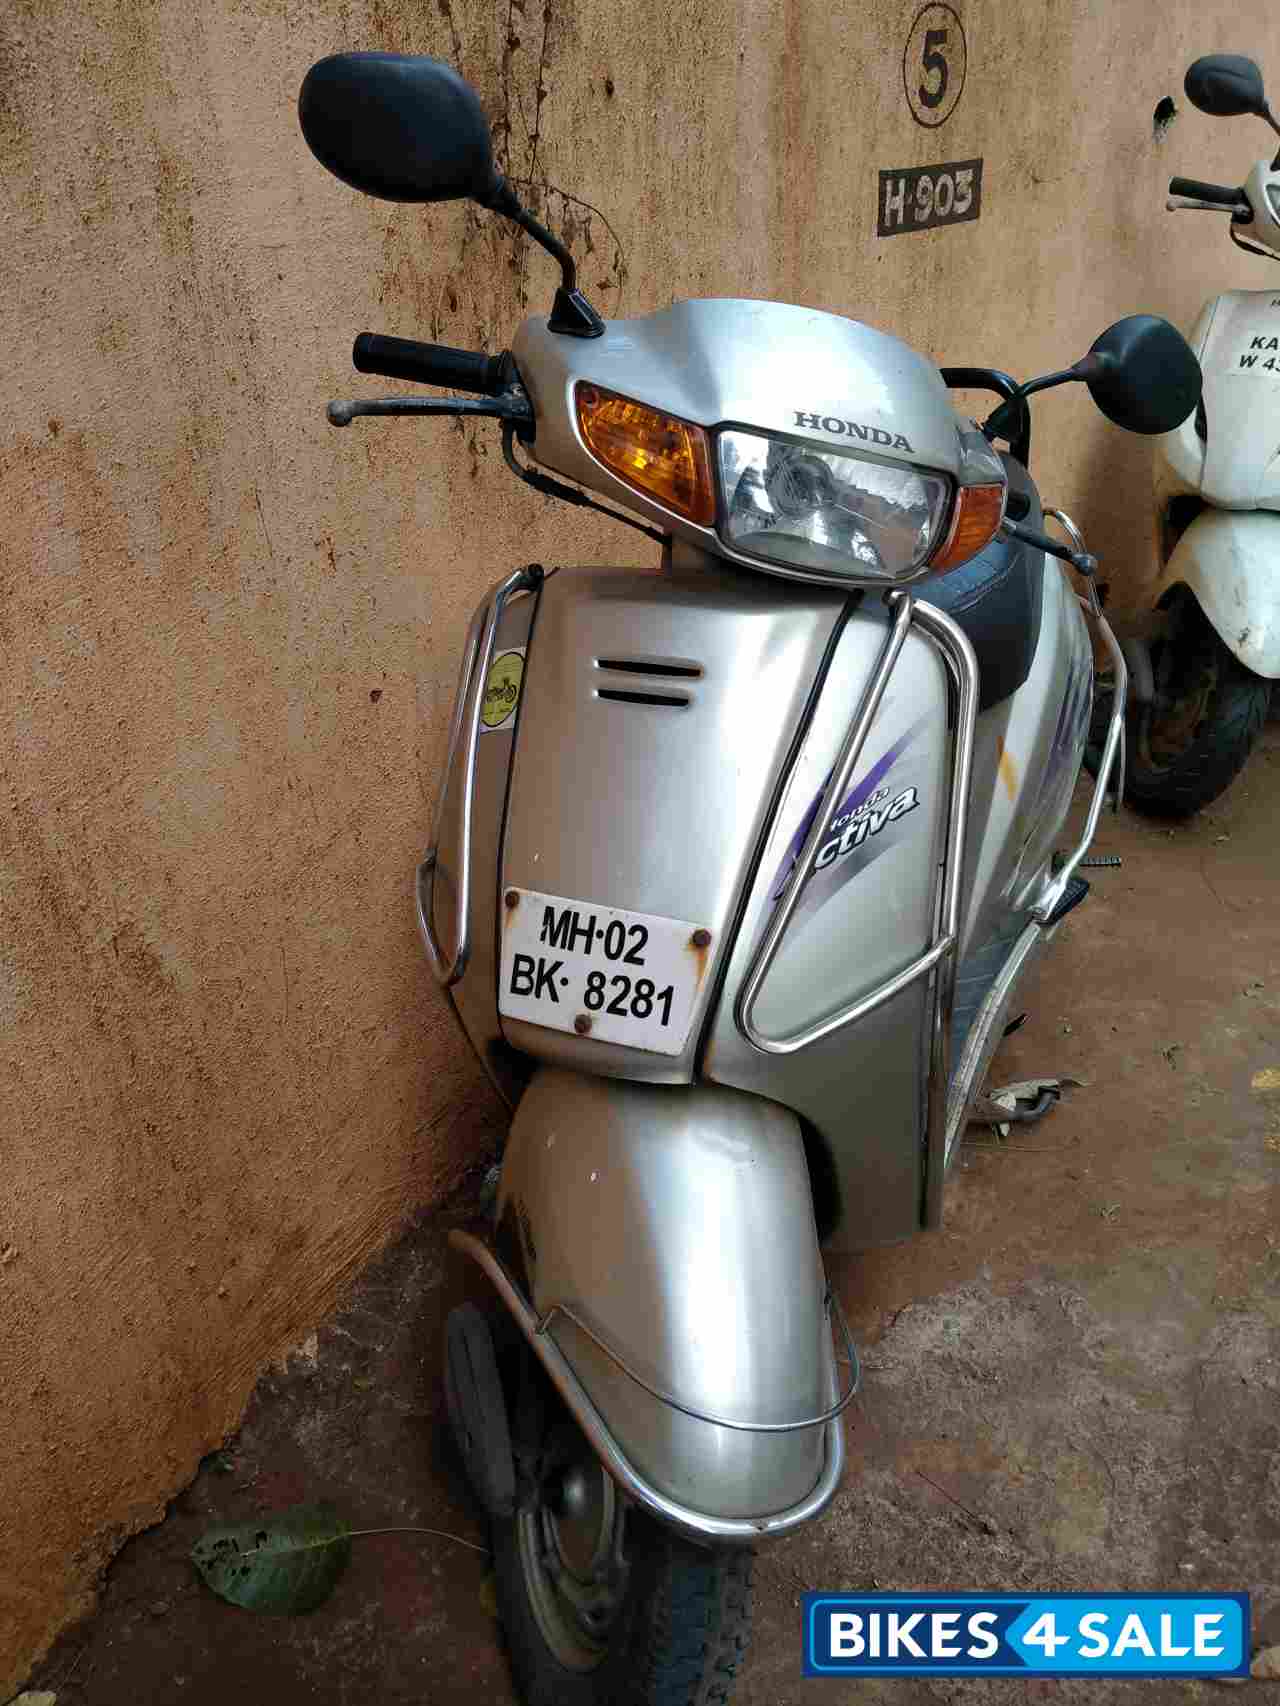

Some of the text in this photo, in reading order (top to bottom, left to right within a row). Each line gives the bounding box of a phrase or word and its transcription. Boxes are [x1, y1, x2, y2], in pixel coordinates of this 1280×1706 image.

[919, 30, 948, 108] 5
[1240, 355, 1258, 369] W
[793, 410, 915, 453] HONDA
[584, 971, 674, 1026] 8281
